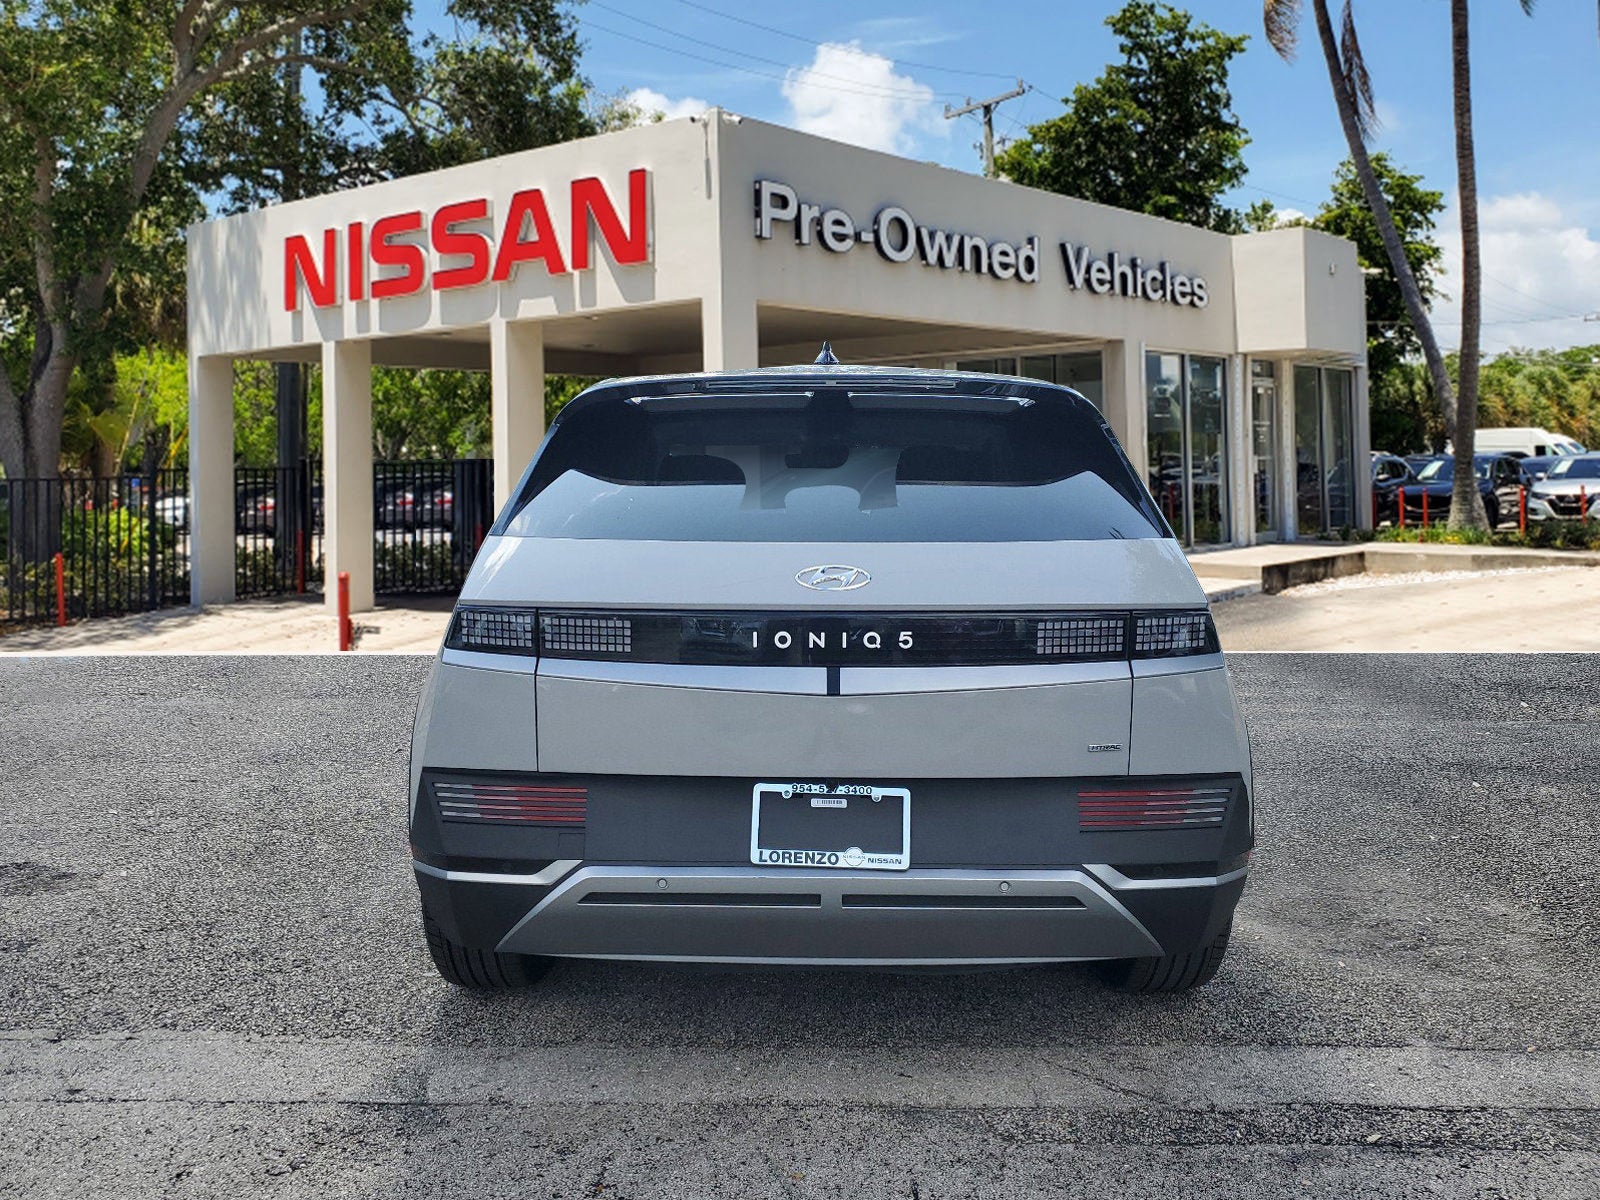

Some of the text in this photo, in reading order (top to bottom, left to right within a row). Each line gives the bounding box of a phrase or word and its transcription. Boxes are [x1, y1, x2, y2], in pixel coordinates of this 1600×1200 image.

[285, 168, 648, 312] NISSAN
[754, 179, 1208, 308] Pre-Owned Vehicles
[752, 630, 913, 649] IONIQ 5
[758, 850, 840, 865] LORENZO
[867, 857, 902, 865] NISSAN
